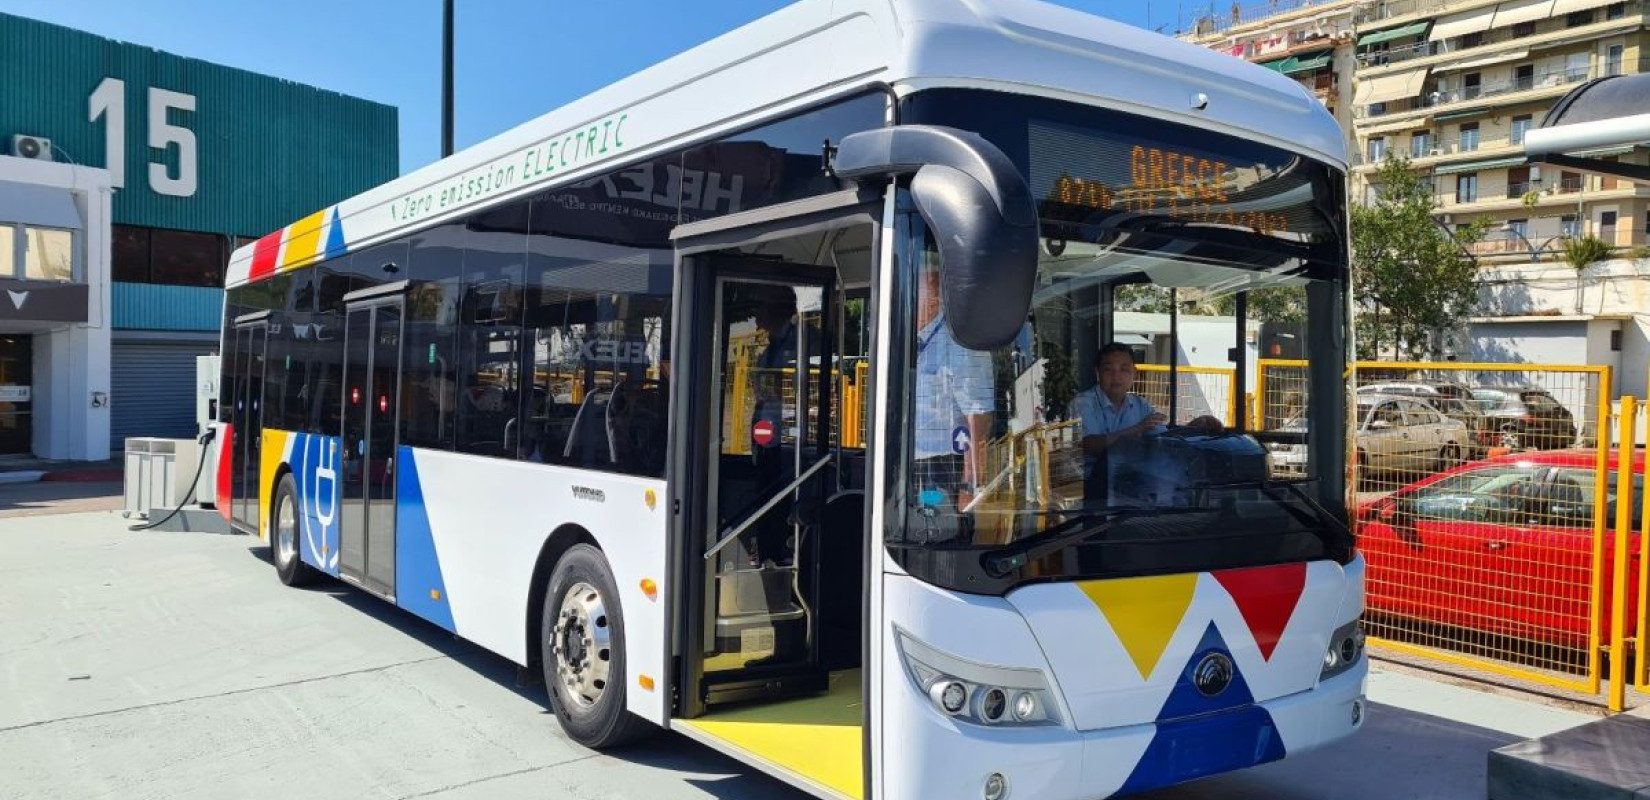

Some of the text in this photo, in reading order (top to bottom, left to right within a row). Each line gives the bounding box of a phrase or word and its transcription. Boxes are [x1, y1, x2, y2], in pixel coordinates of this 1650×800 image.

[88, 77, 197, 197] 15
[403, 194, 432, 219] Zero
[441, 165, 514, 207] emission
[523, 114, 627, 180] ELECTRIC
[1131, 145, 1230, 203] GREECE
